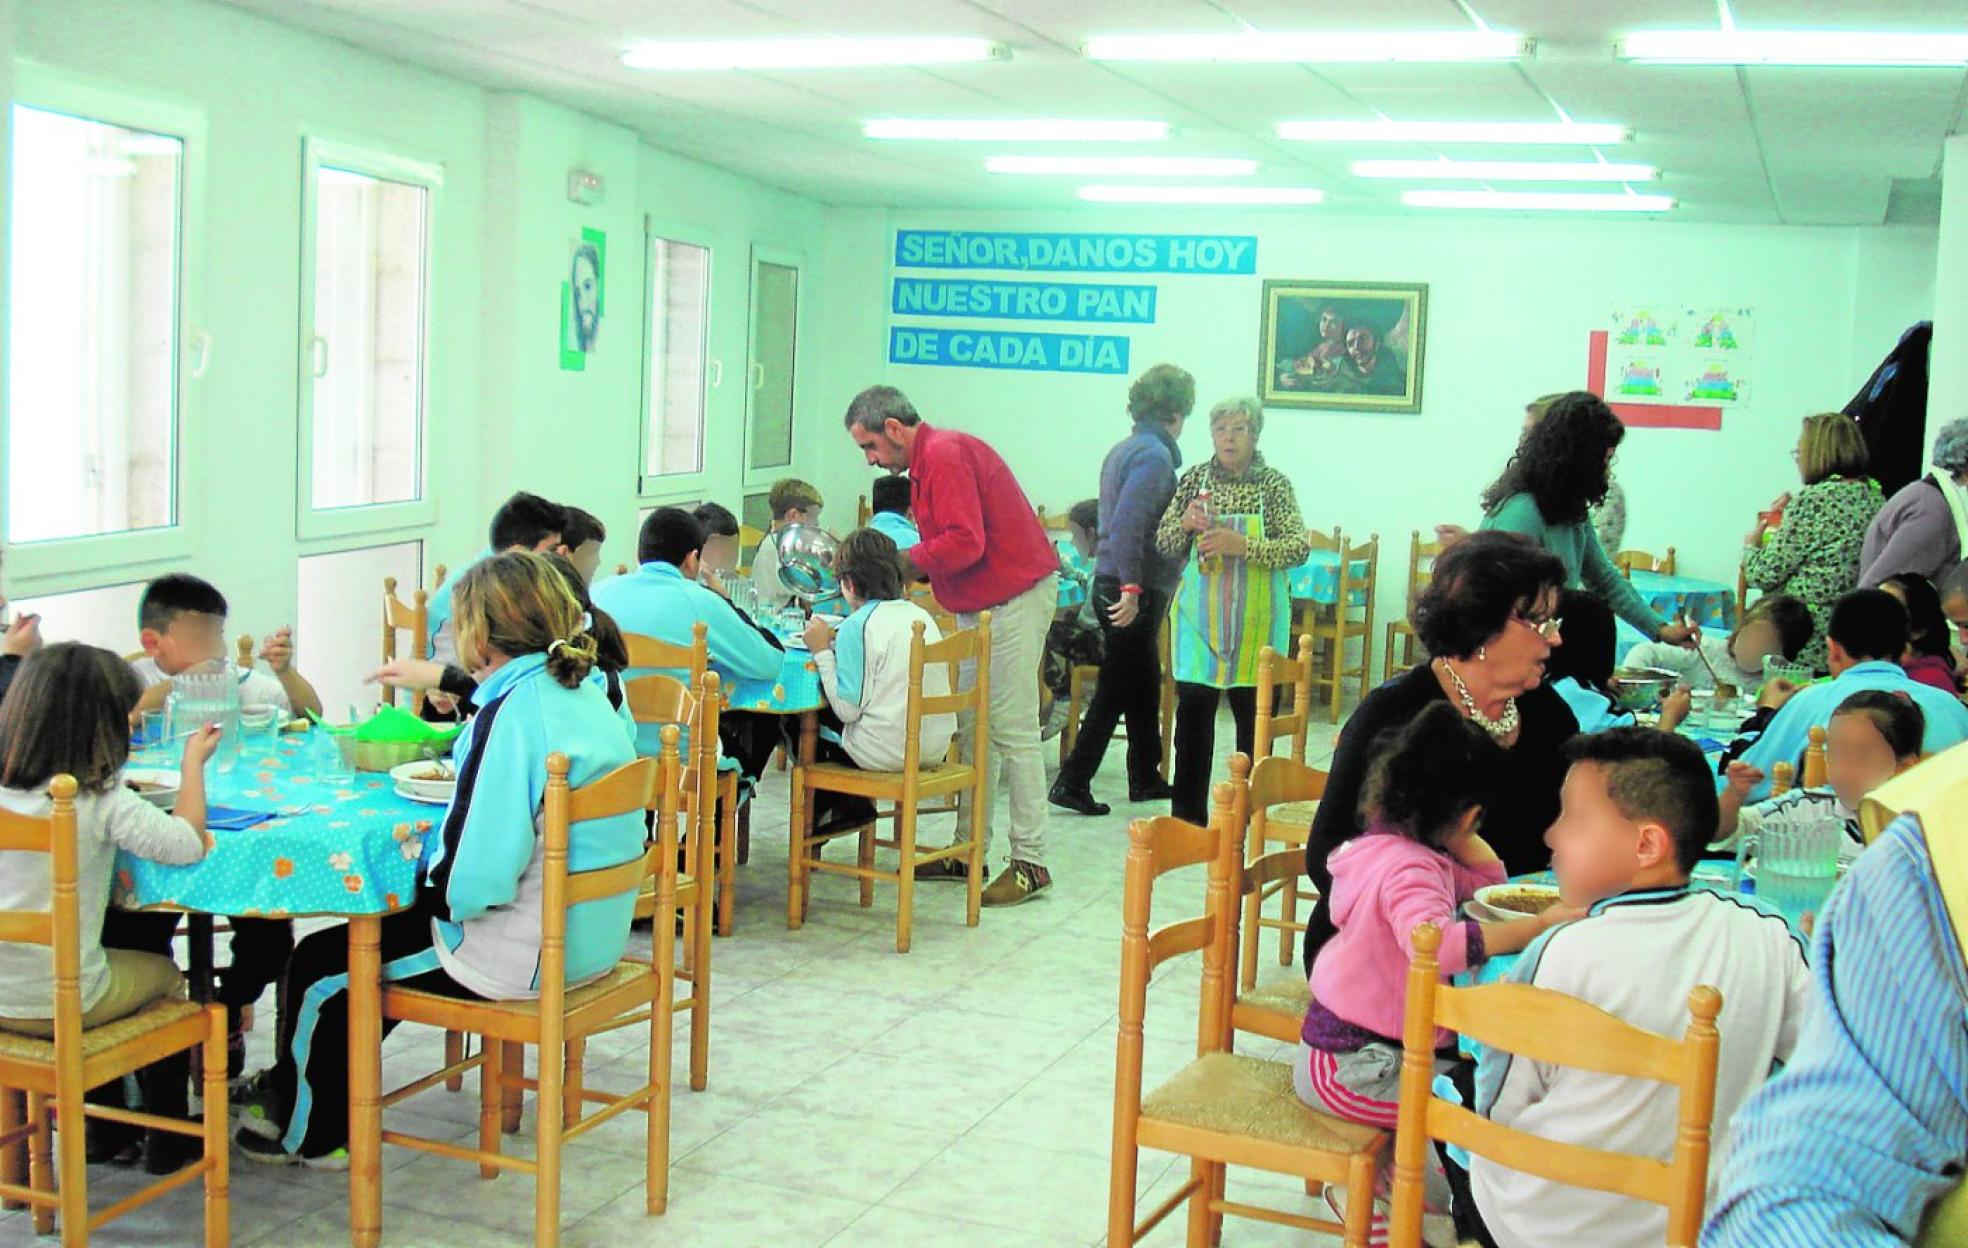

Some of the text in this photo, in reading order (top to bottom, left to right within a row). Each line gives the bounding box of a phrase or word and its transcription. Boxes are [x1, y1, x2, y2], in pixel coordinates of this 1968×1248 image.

[1168, 239, 1248, 270] HOY
[899, 283, 1149, 318] NUESTRO PAN
[895, 331, 1121, 369] DE CADA DÍA
